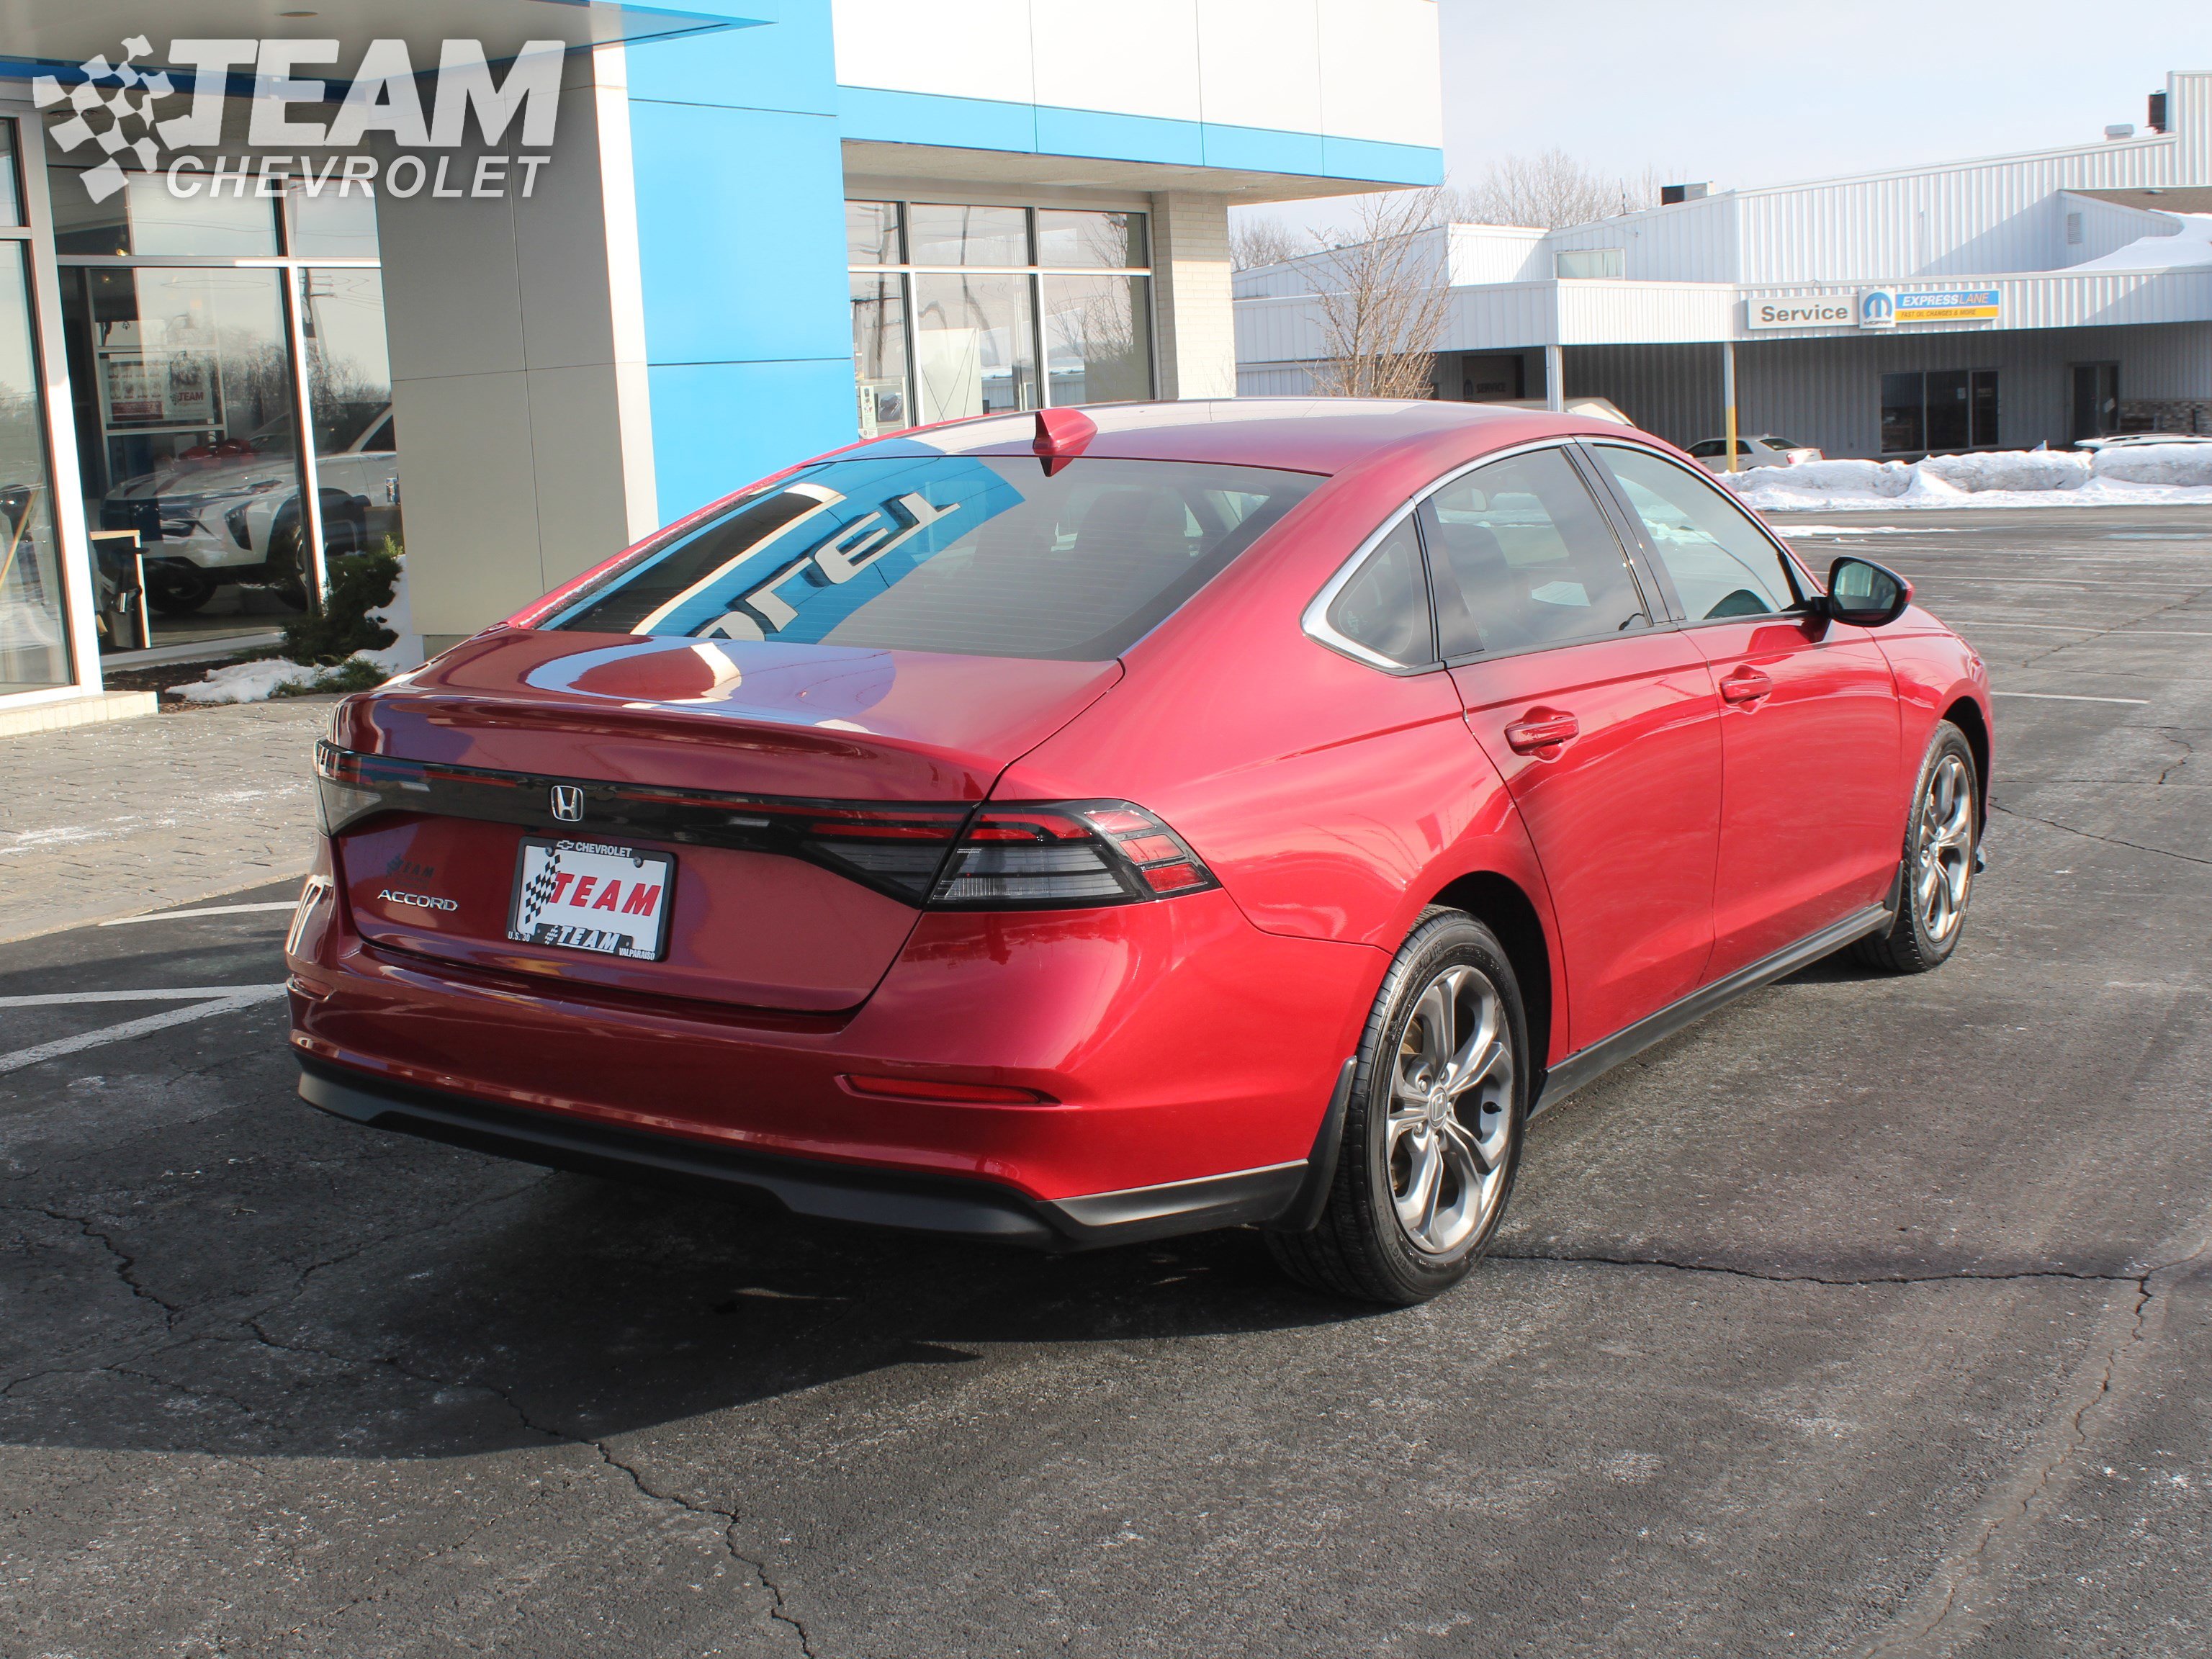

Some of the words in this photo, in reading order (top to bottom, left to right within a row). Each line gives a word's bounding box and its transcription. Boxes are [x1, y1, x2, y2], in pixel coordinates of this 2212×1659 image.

[1761, 304, 1848, 323] Service
[179, 391, 204, 401] TEAM
[575, 842, 632, 858] CHEVROLET
[377, 889, 458, 911] ACCORD
[549, 872, 662, 917] TEAM
[508, 930, 521, 940] U.S.
[522, 933, 531, 942] 30
[557, 925, 621, 951] TEAM
[619, 947, 656, 961] VALPARAISO
[1388, 1240, 1416, 1279] ENERGY
